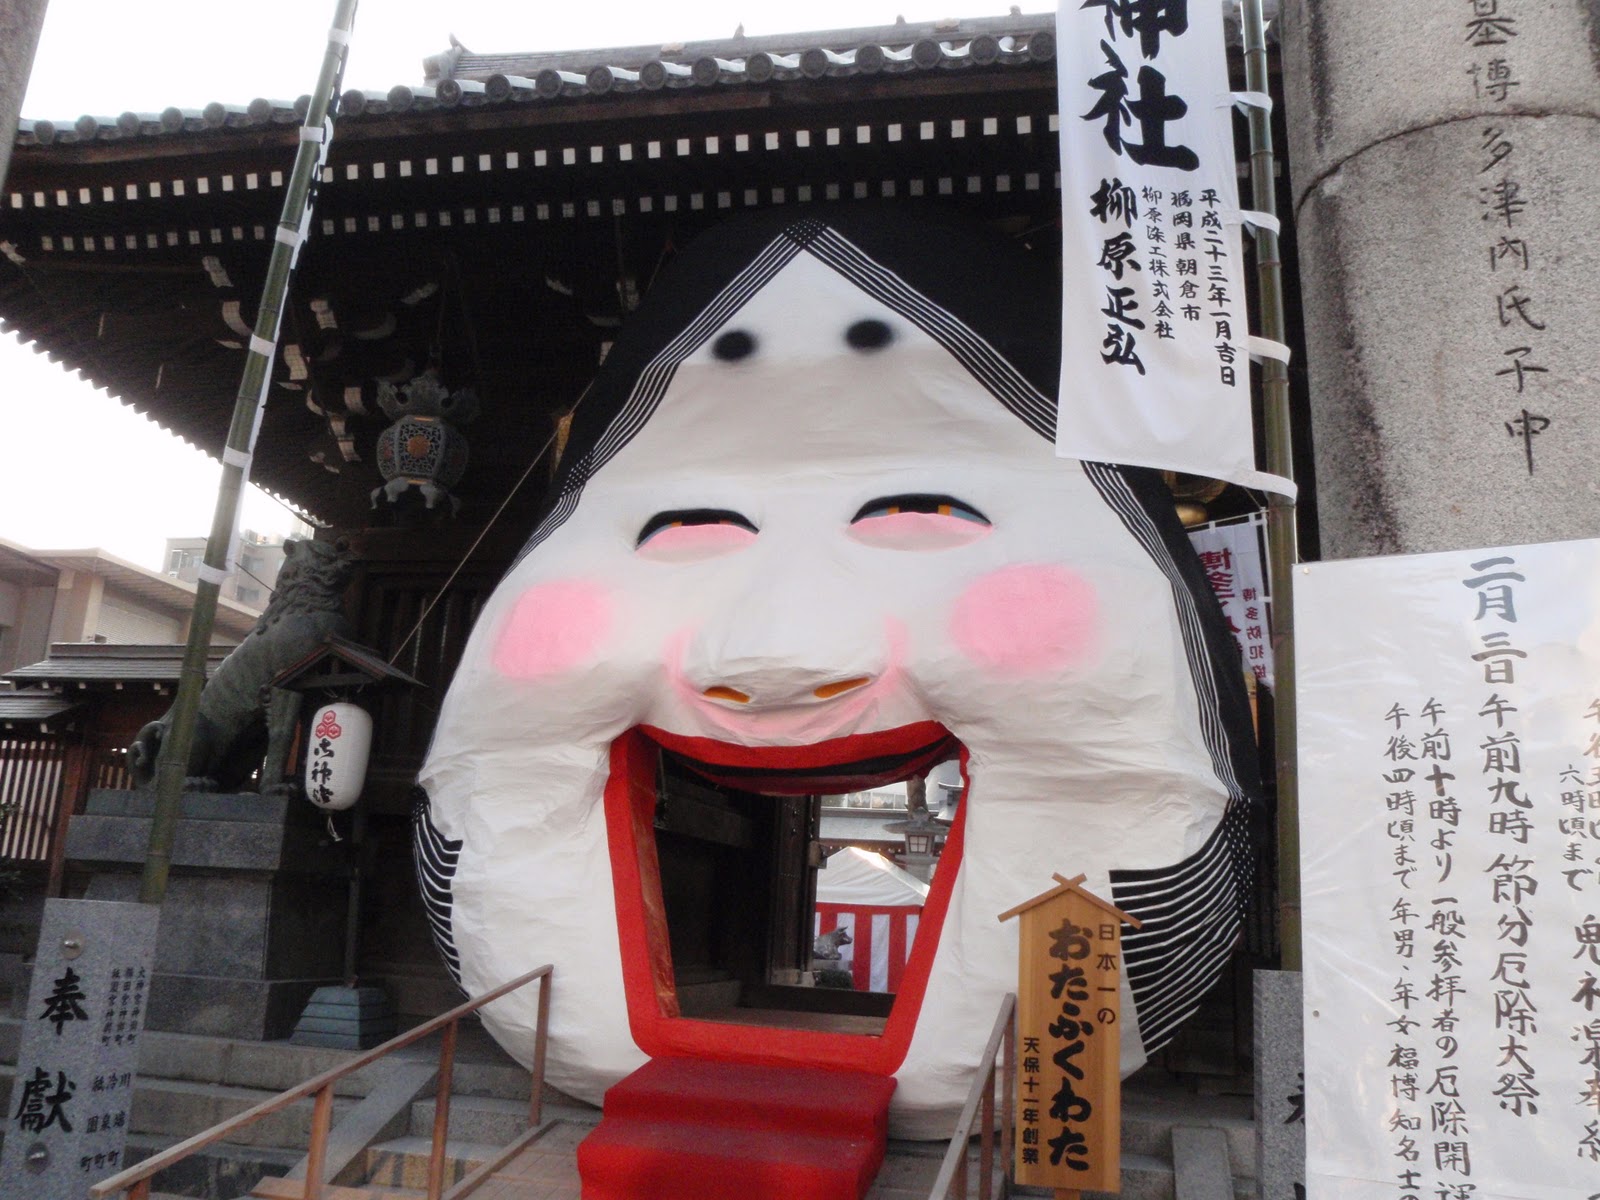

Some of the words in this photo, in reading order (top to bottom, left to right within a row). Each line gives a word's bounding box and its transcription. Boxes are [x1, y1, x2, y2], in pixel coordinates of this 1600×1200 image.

[1089, 177, 1146, 376] 柳原正弘
[1142, 185, 1176, 340] 柳原染工株式会社
[1170, 190, 1202, 322] 福岡県朝倉市
[1198, 188, 1236, 387] 平成二十三年一月吉日
[1096, 923, 1117, 1025] 日本一の
[1382, 702, 1422, 1200] 午後四時頃まで年男、年女福博知名士
[1022, 1036, 1040, 1165] 天保十一年創業
[1047, 918, 1094, 1171] おたふくわた
